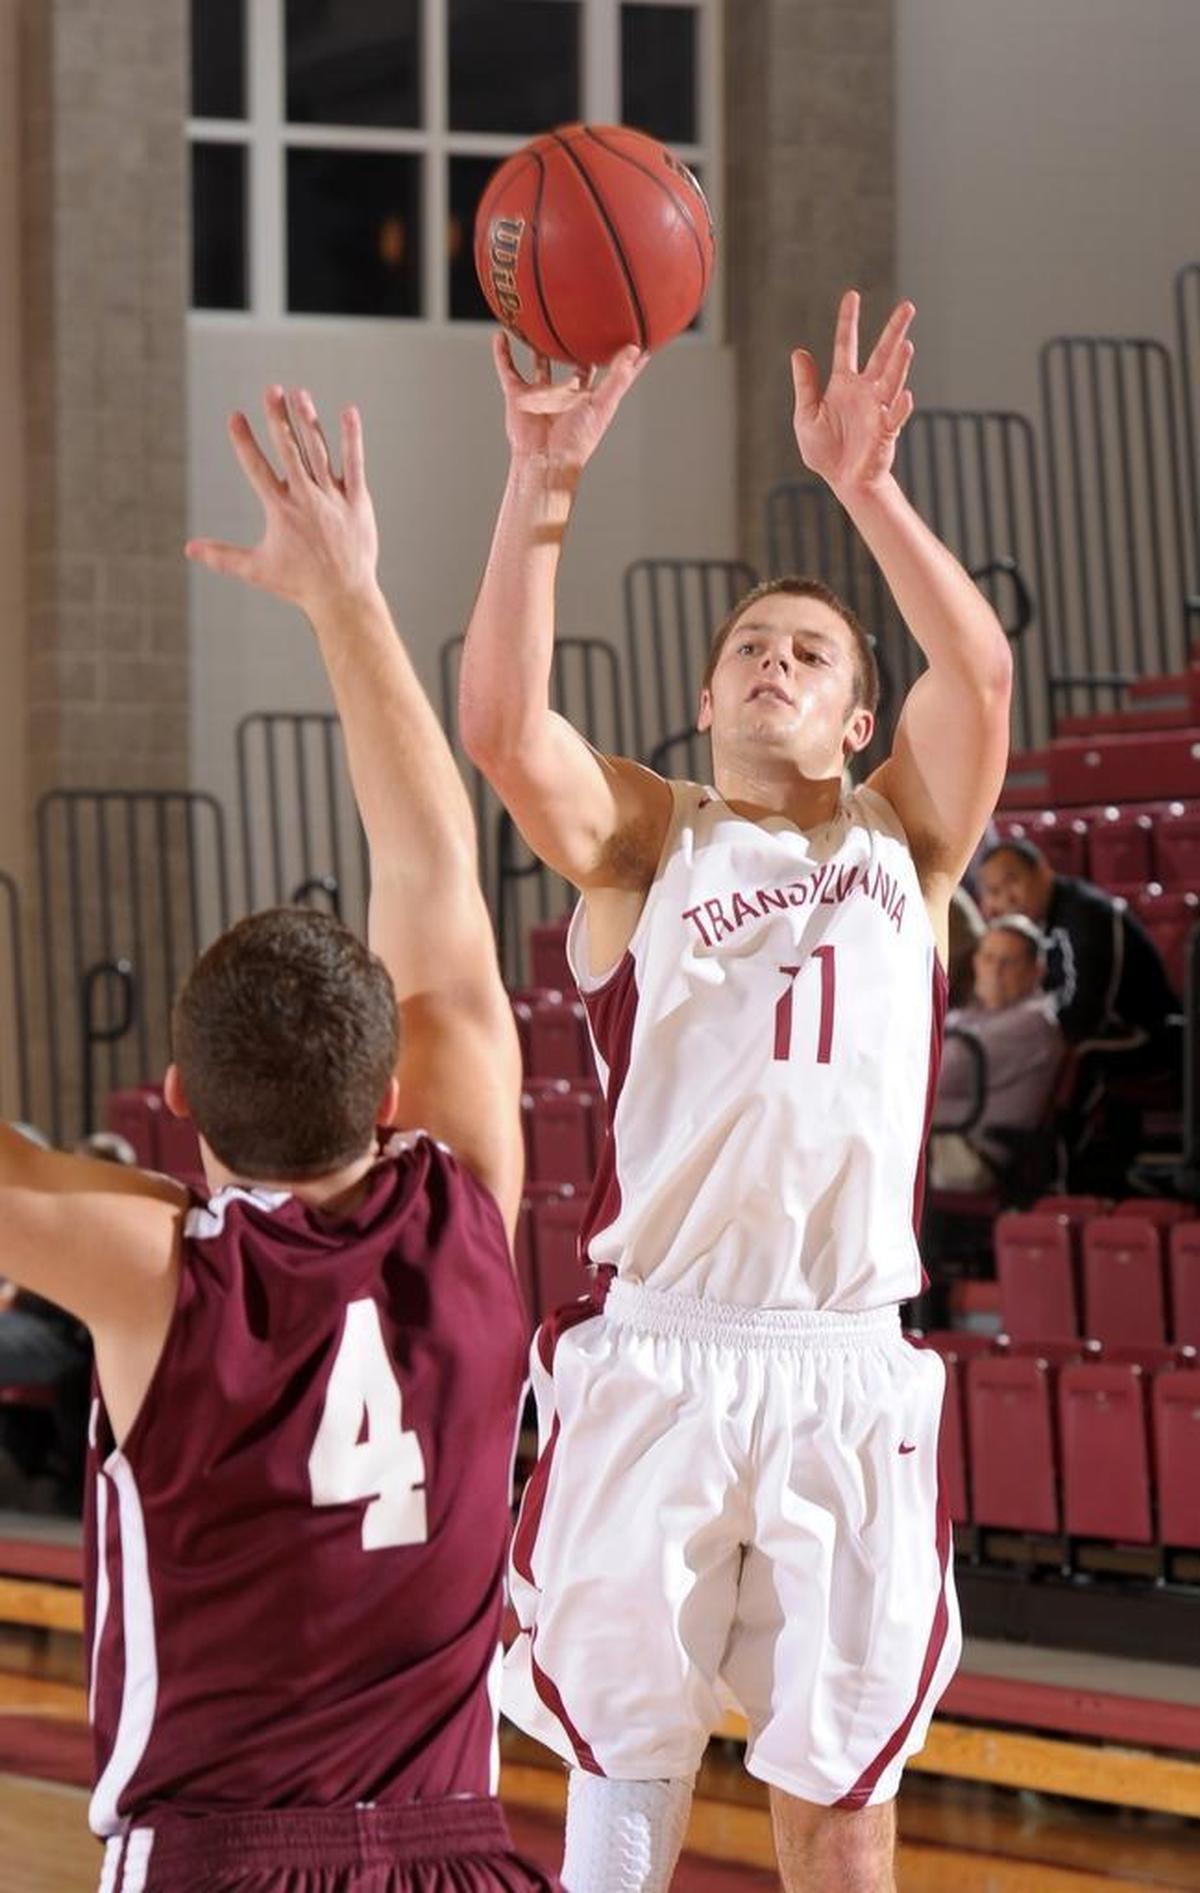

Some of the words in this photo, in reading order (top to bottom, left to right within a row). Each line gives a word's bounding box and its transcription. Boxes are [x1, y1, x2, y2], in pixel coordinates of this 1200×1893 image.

[682, 863, 906, 947] TRANSYLVANIA
[773, 945, 836, 1064] 11
[308, 1297, 428, 1551] 4
